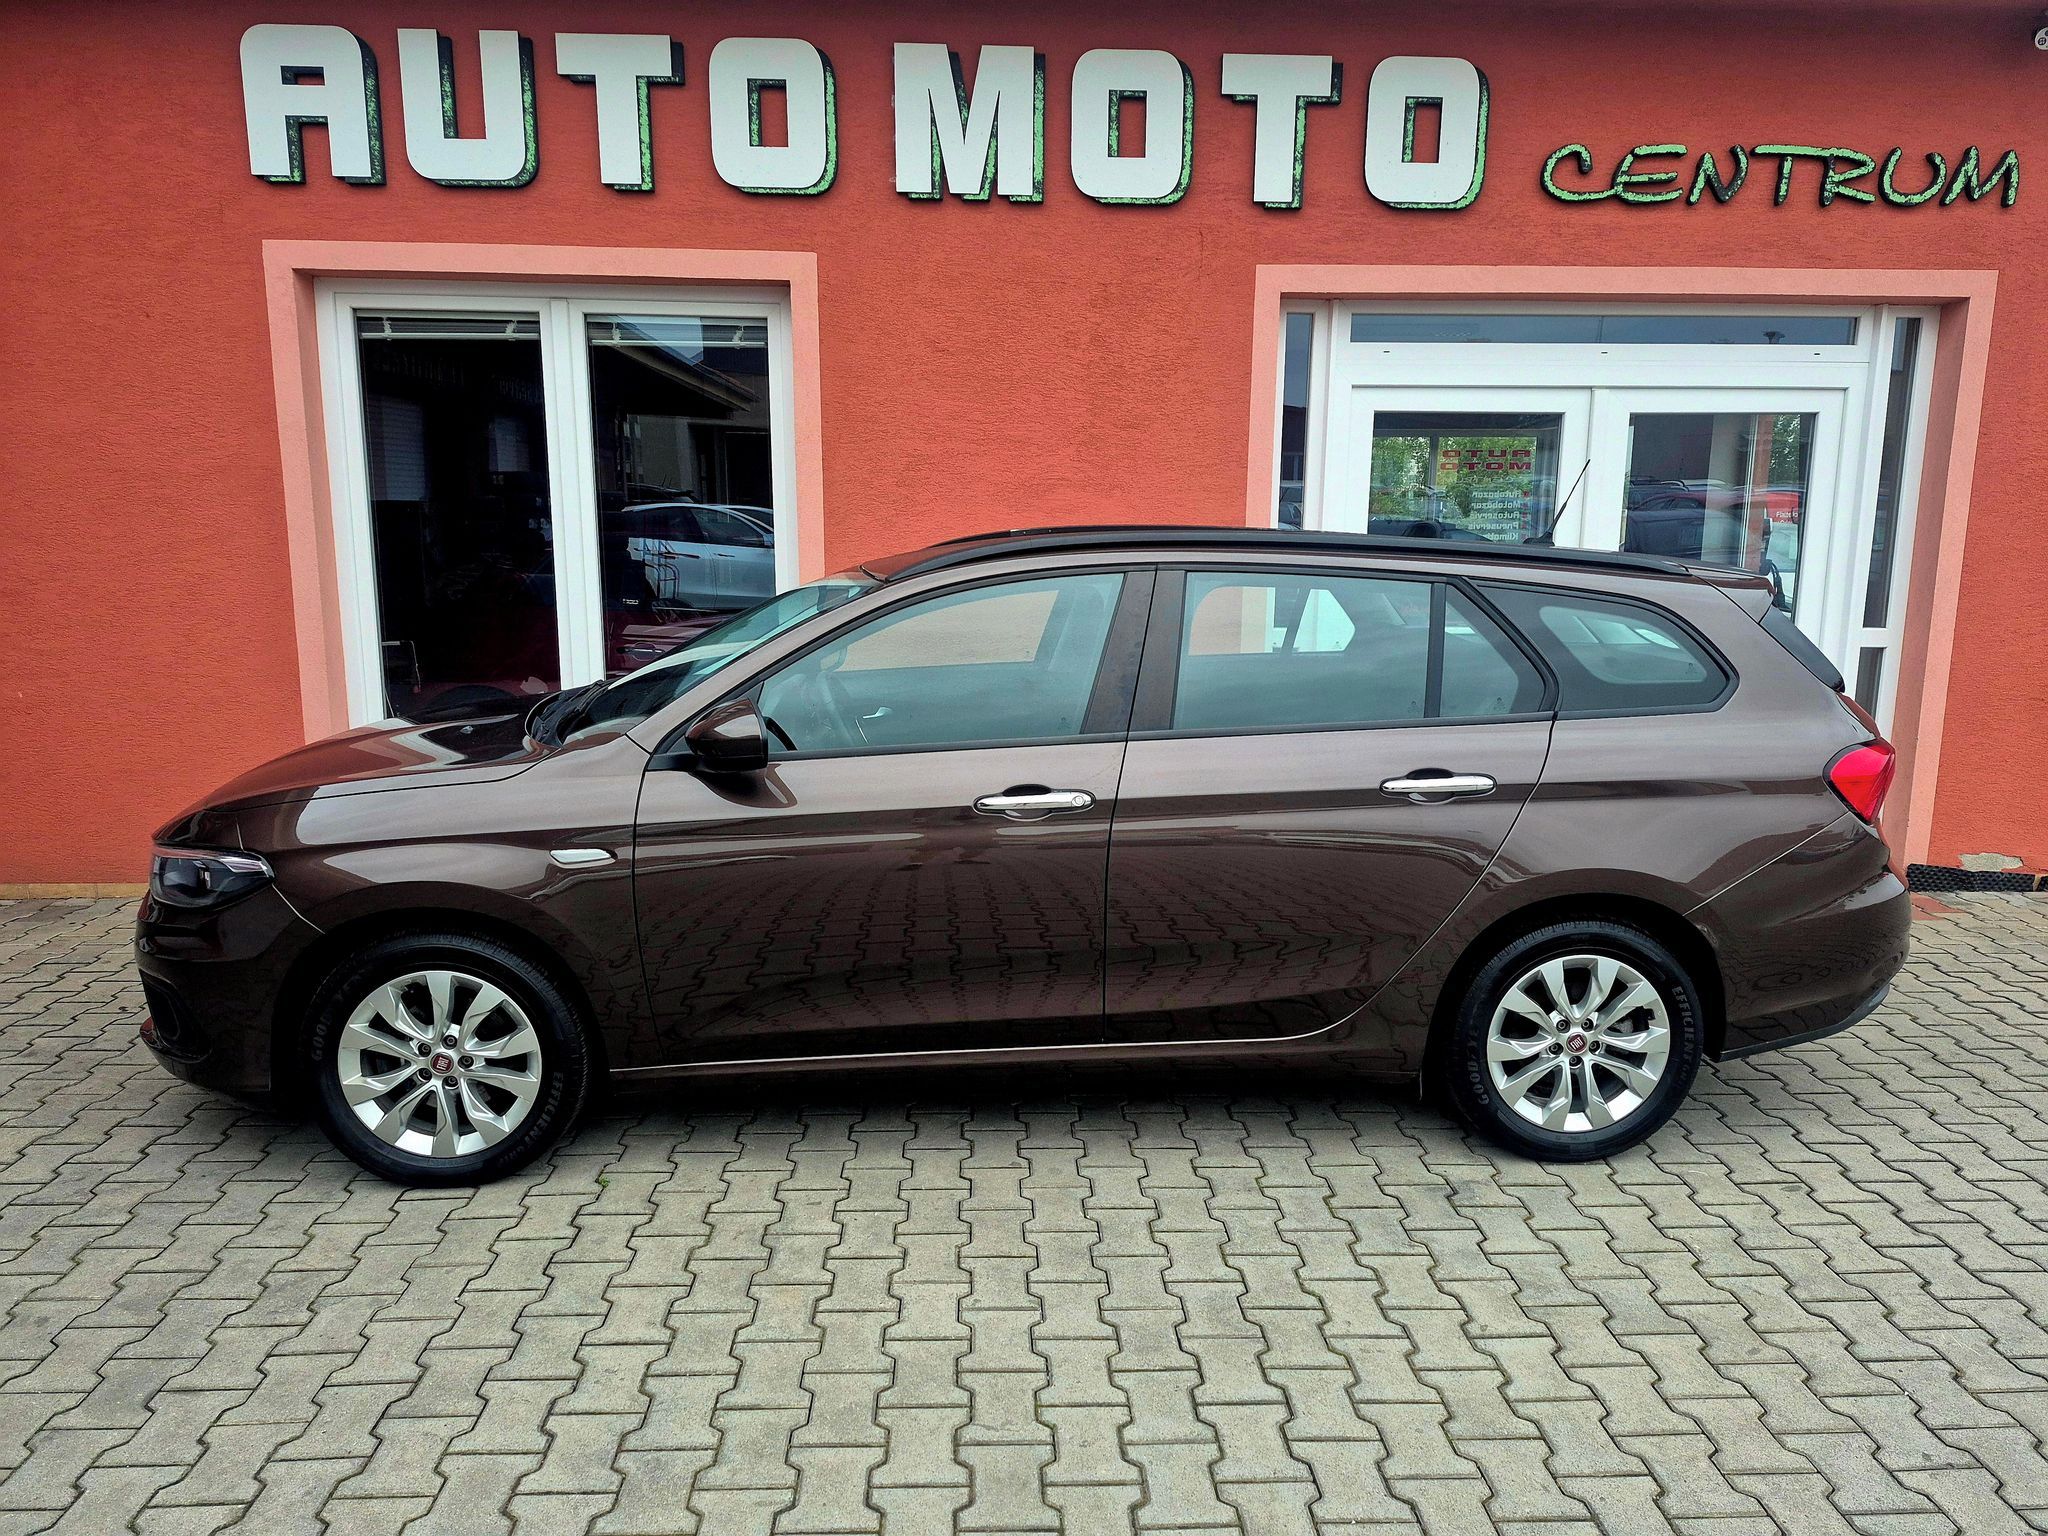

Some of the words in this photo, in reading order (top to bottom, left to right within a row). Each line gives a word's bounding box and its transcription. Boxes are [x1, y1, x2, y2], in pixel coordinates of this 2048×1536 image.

[240, 24, 837, 194] AUTO
[893, 42, 1489, 209] MOTO
[1540, 143, 2020, 208] CENTRUM
